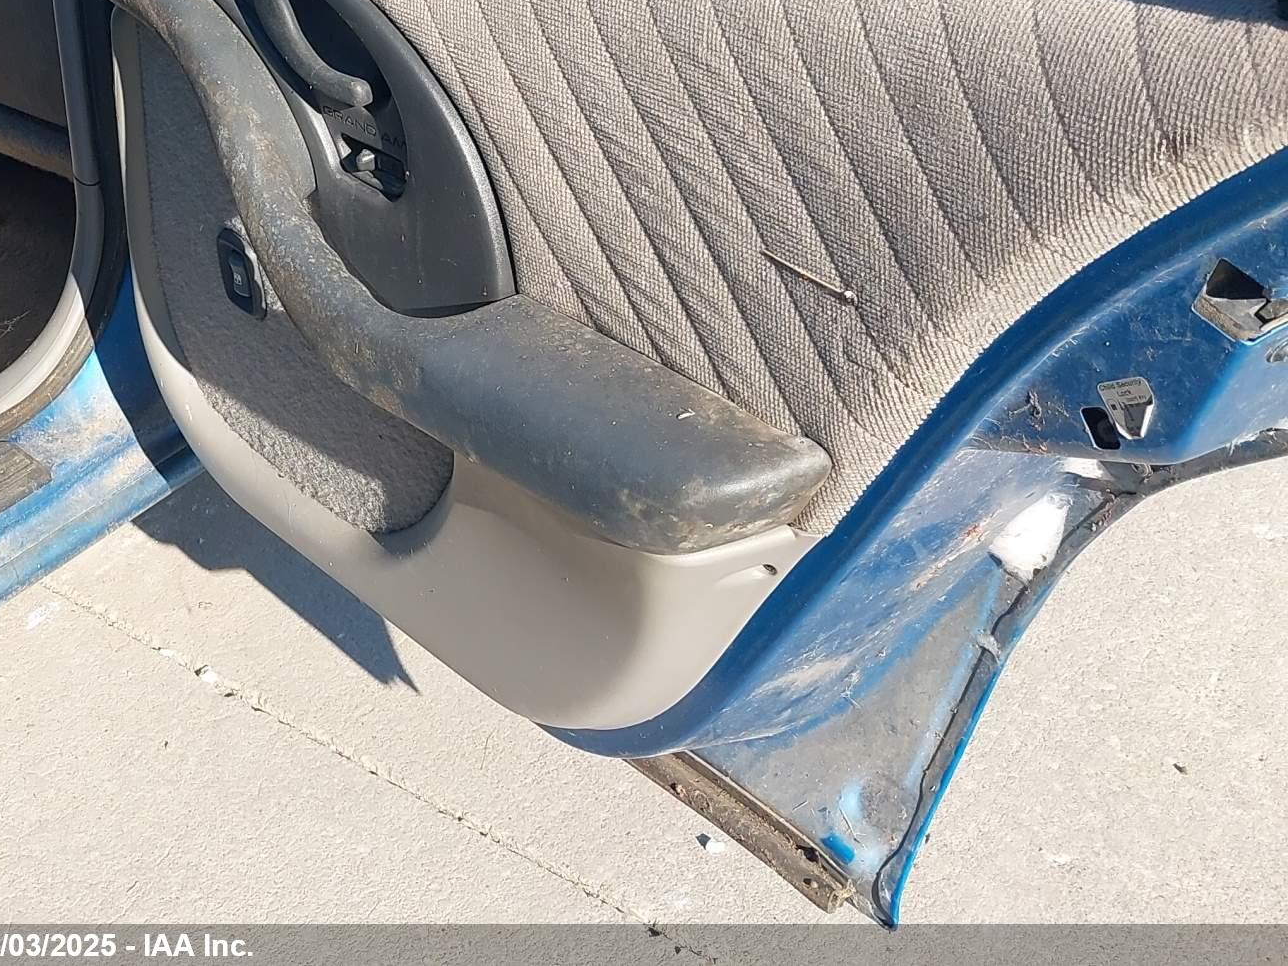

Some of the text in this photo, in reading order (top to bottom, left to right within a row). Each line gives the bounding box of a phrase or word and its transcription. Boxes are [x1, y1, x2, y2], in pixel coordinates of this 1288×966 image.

[323, 105, 407, 147] GRAND AM
[1116, 378, 1142, 388] Security
